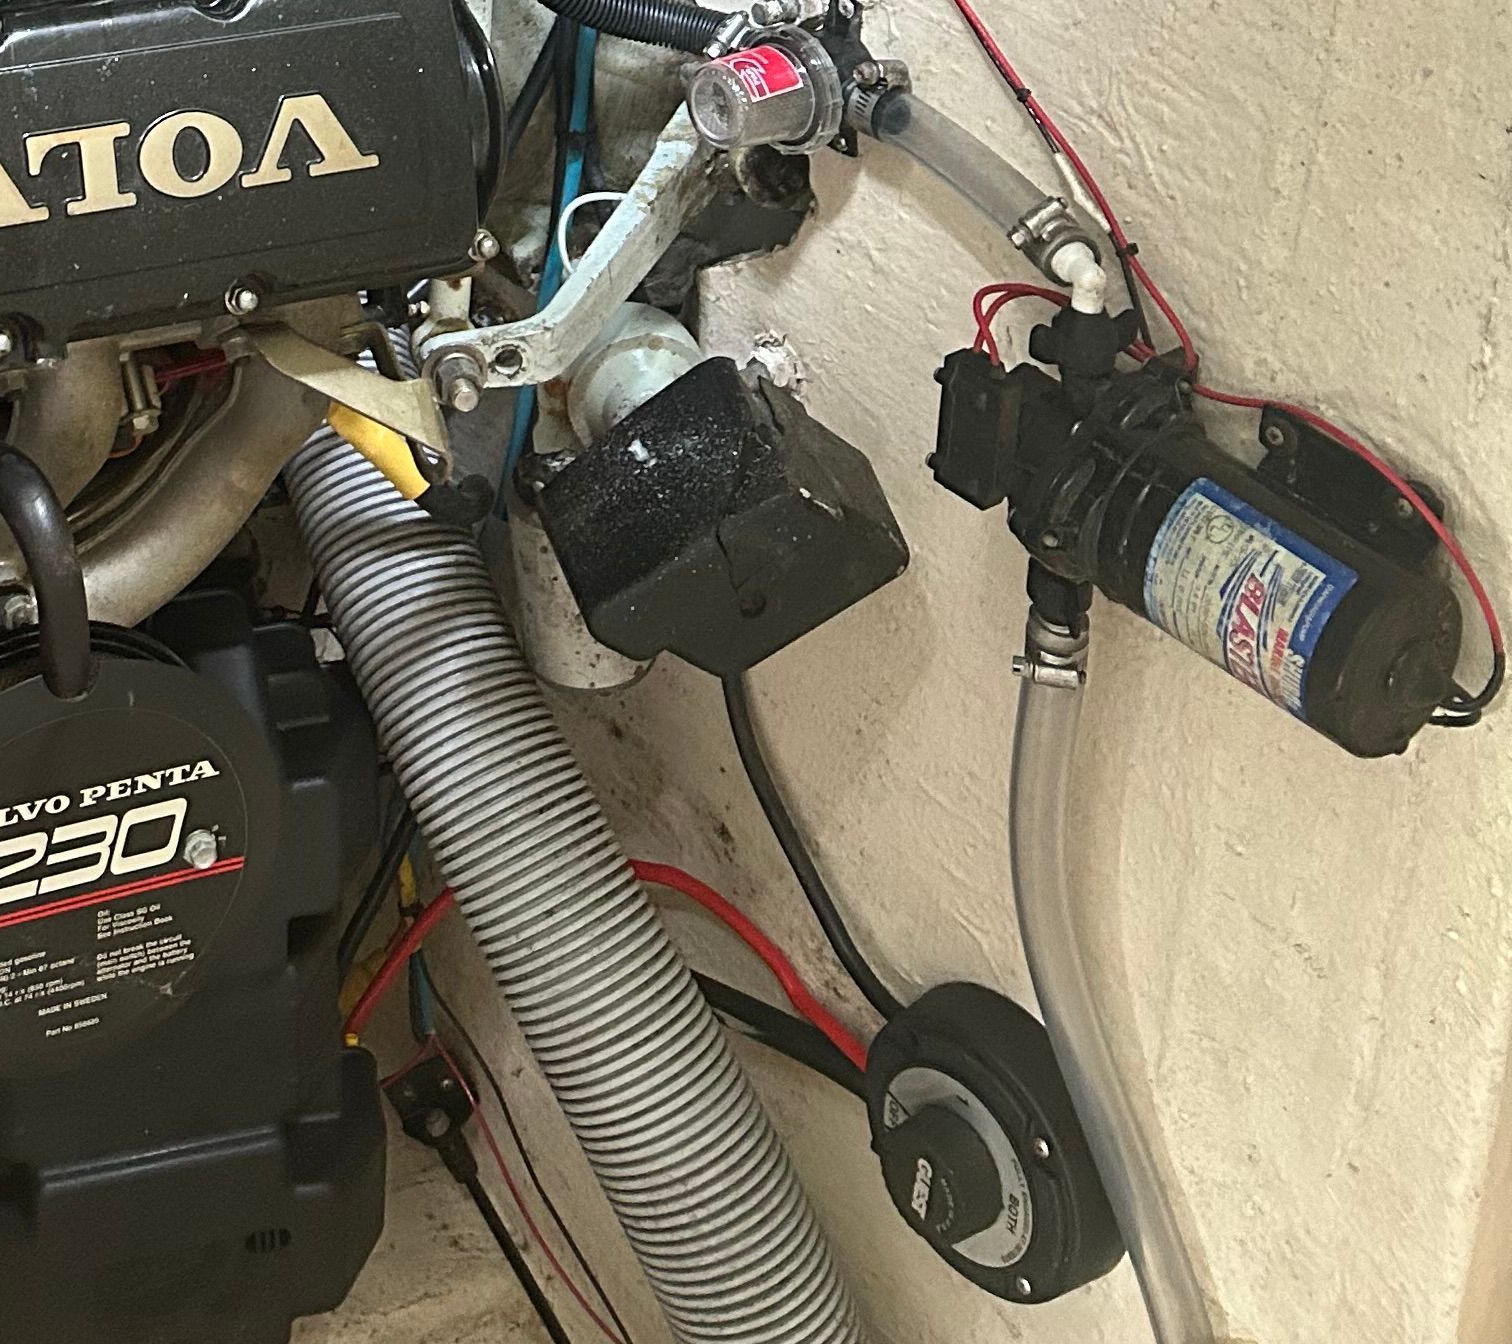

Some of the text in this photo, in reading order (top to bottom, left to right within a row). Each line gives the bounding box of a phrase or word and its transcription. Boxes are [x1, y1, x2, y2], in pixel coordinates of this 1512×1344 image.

[79, 759, 220, 807] PENTA
[114, 904, 161, 921] Class Oil
[98, 924, 110, 932] For
[113, 921, 153, 936] Instruction
[109, 949, 122, 957] not
[123, 944, 144, 954] break
[133, 947, 188, 965] and battery
[147, 943, 178, 954] between
[131, 953, 195, 973] engine running
[39, 992, 108, 1016] MADE IN SWEDEN
[46, 1024, 72, 1037] Part No
[1007, 1193, 1020, 1234] BOTH
